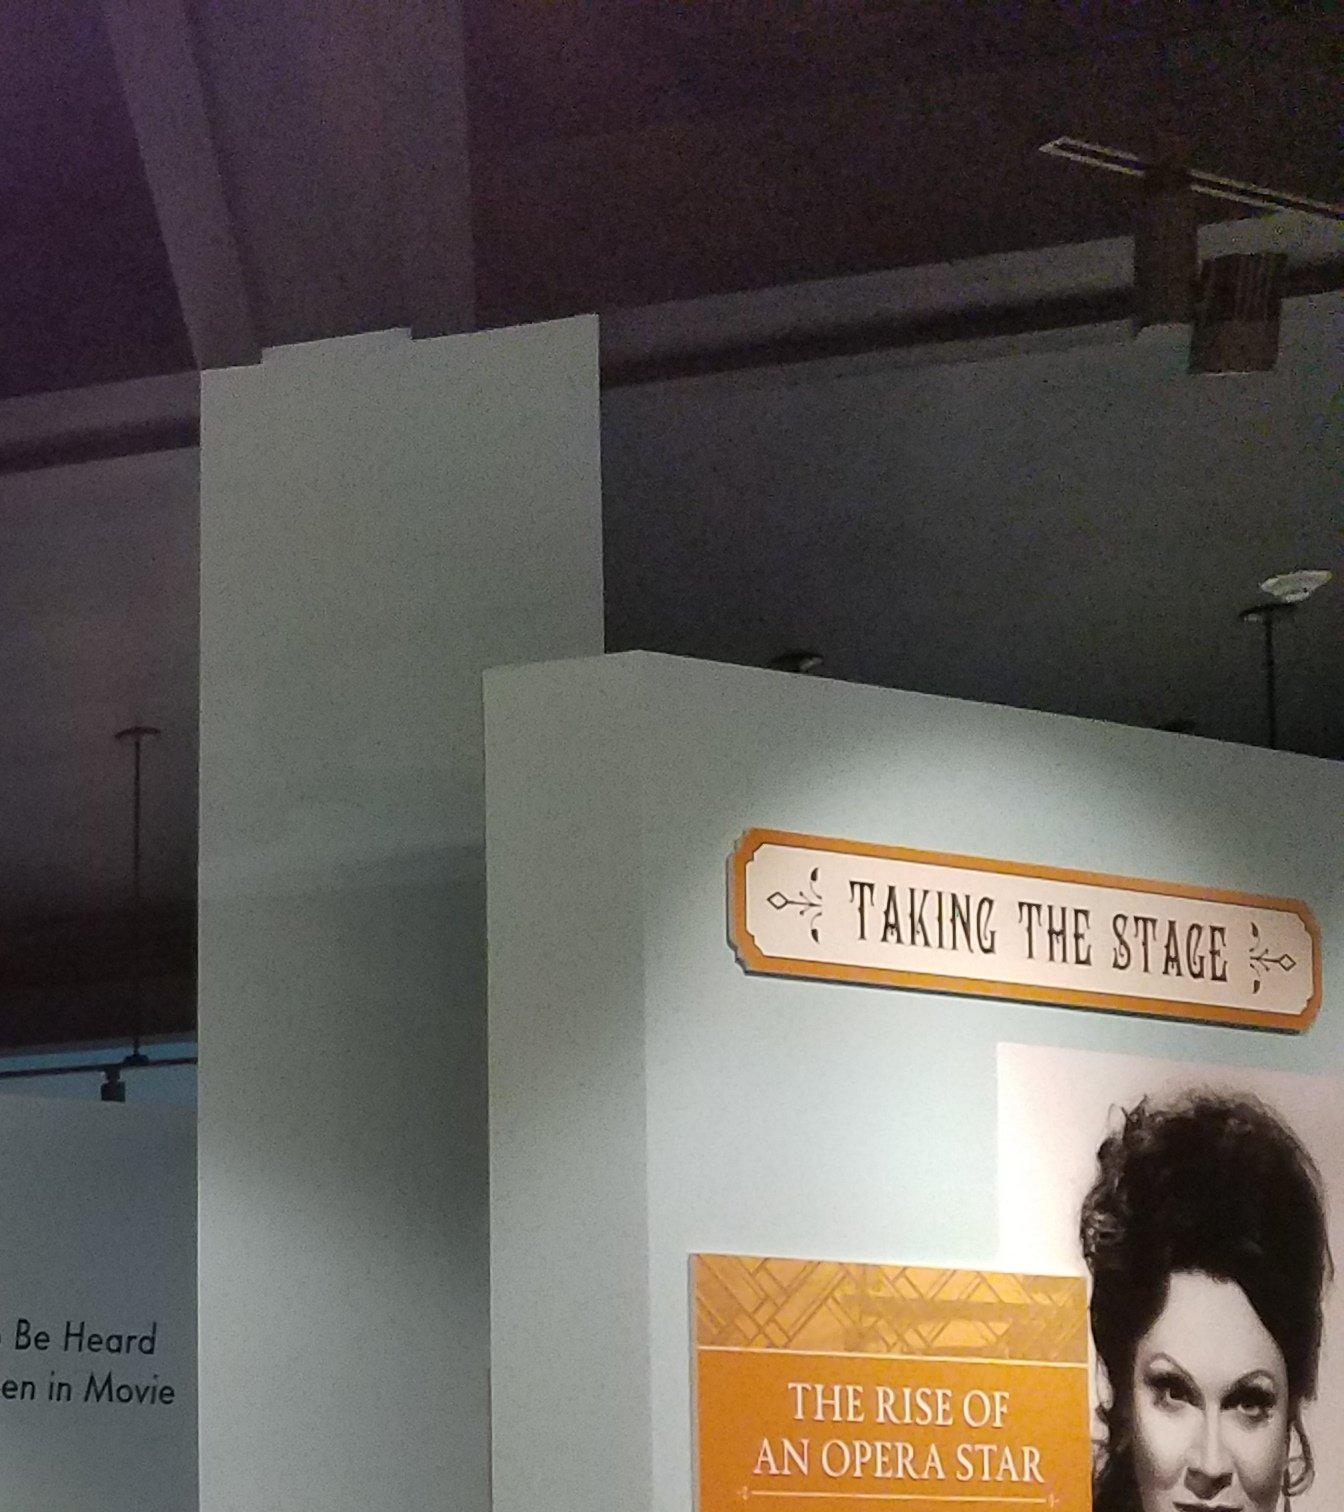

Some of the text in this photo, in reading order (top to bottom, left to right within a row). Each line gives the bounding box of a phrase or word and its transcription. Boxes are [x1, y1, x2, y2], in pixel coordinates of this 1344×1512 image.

[848, 880, 1229, 984] TAKING THE STAGE
[15, 1318, 52, 1352] Be
[63, 1320, 158, 1355] Heard
[48, 1370, 72, 1402] in
[82, 1371, 177, 1406] Movie
[786, 1381, 1012, 1430] THE RISE OF
[751, 1437, 1047, 1485] AN OPERA STAR
